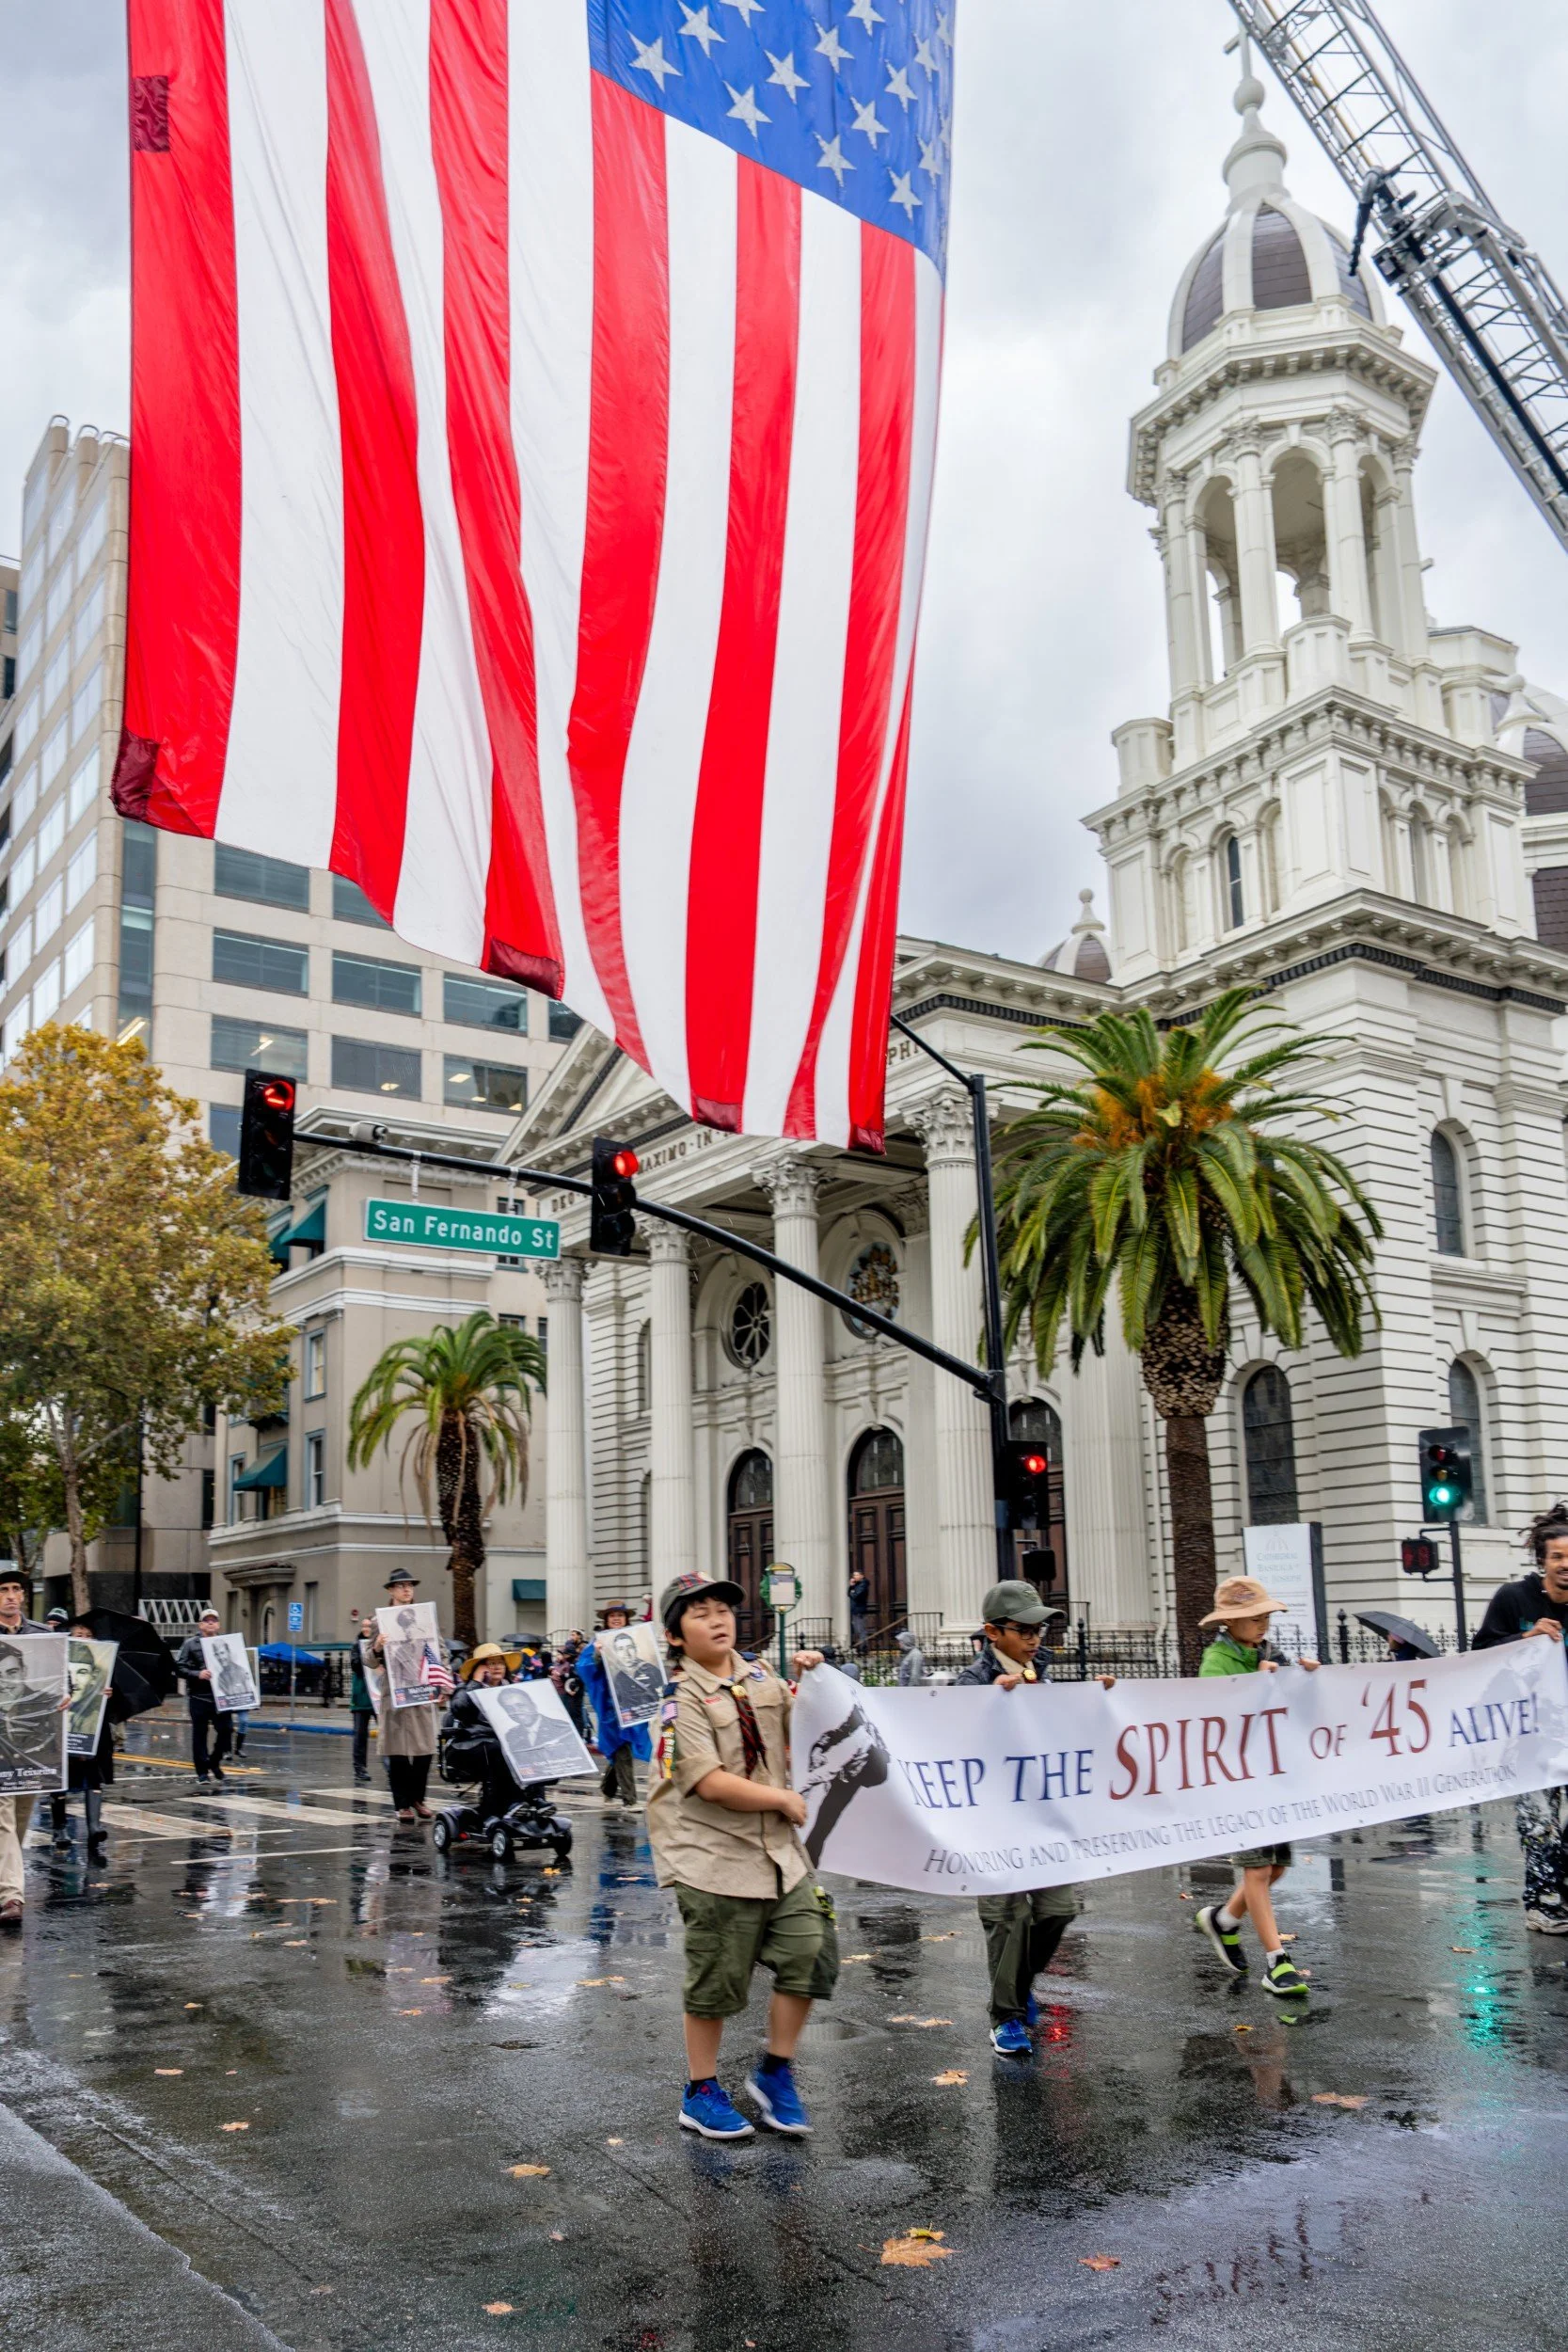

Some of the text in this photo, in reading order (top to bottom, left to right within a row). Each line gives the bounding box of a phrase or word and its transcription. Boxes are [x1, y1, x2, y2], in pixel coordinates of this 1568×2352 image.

[551, 1192, 575, 1213] DEO
[697, 1129, 713, 1149] IN
[373, 1210, 554, 1249] San Fernando St
[896, 1757, 986, 1809] KEEP
[1004, 1748, 1095, 1804] THE
[1109, 1707, 1289, 1801] SPIRIT
[1308, 1724, 1348, 1760] OF
[1448, 1692, 1540, 1748] ALIVE!
[922, 1763, 1519, 1875] HONORING AND PRESERVING THE LEGACY OF THE WORLD WAR II GENERATION
